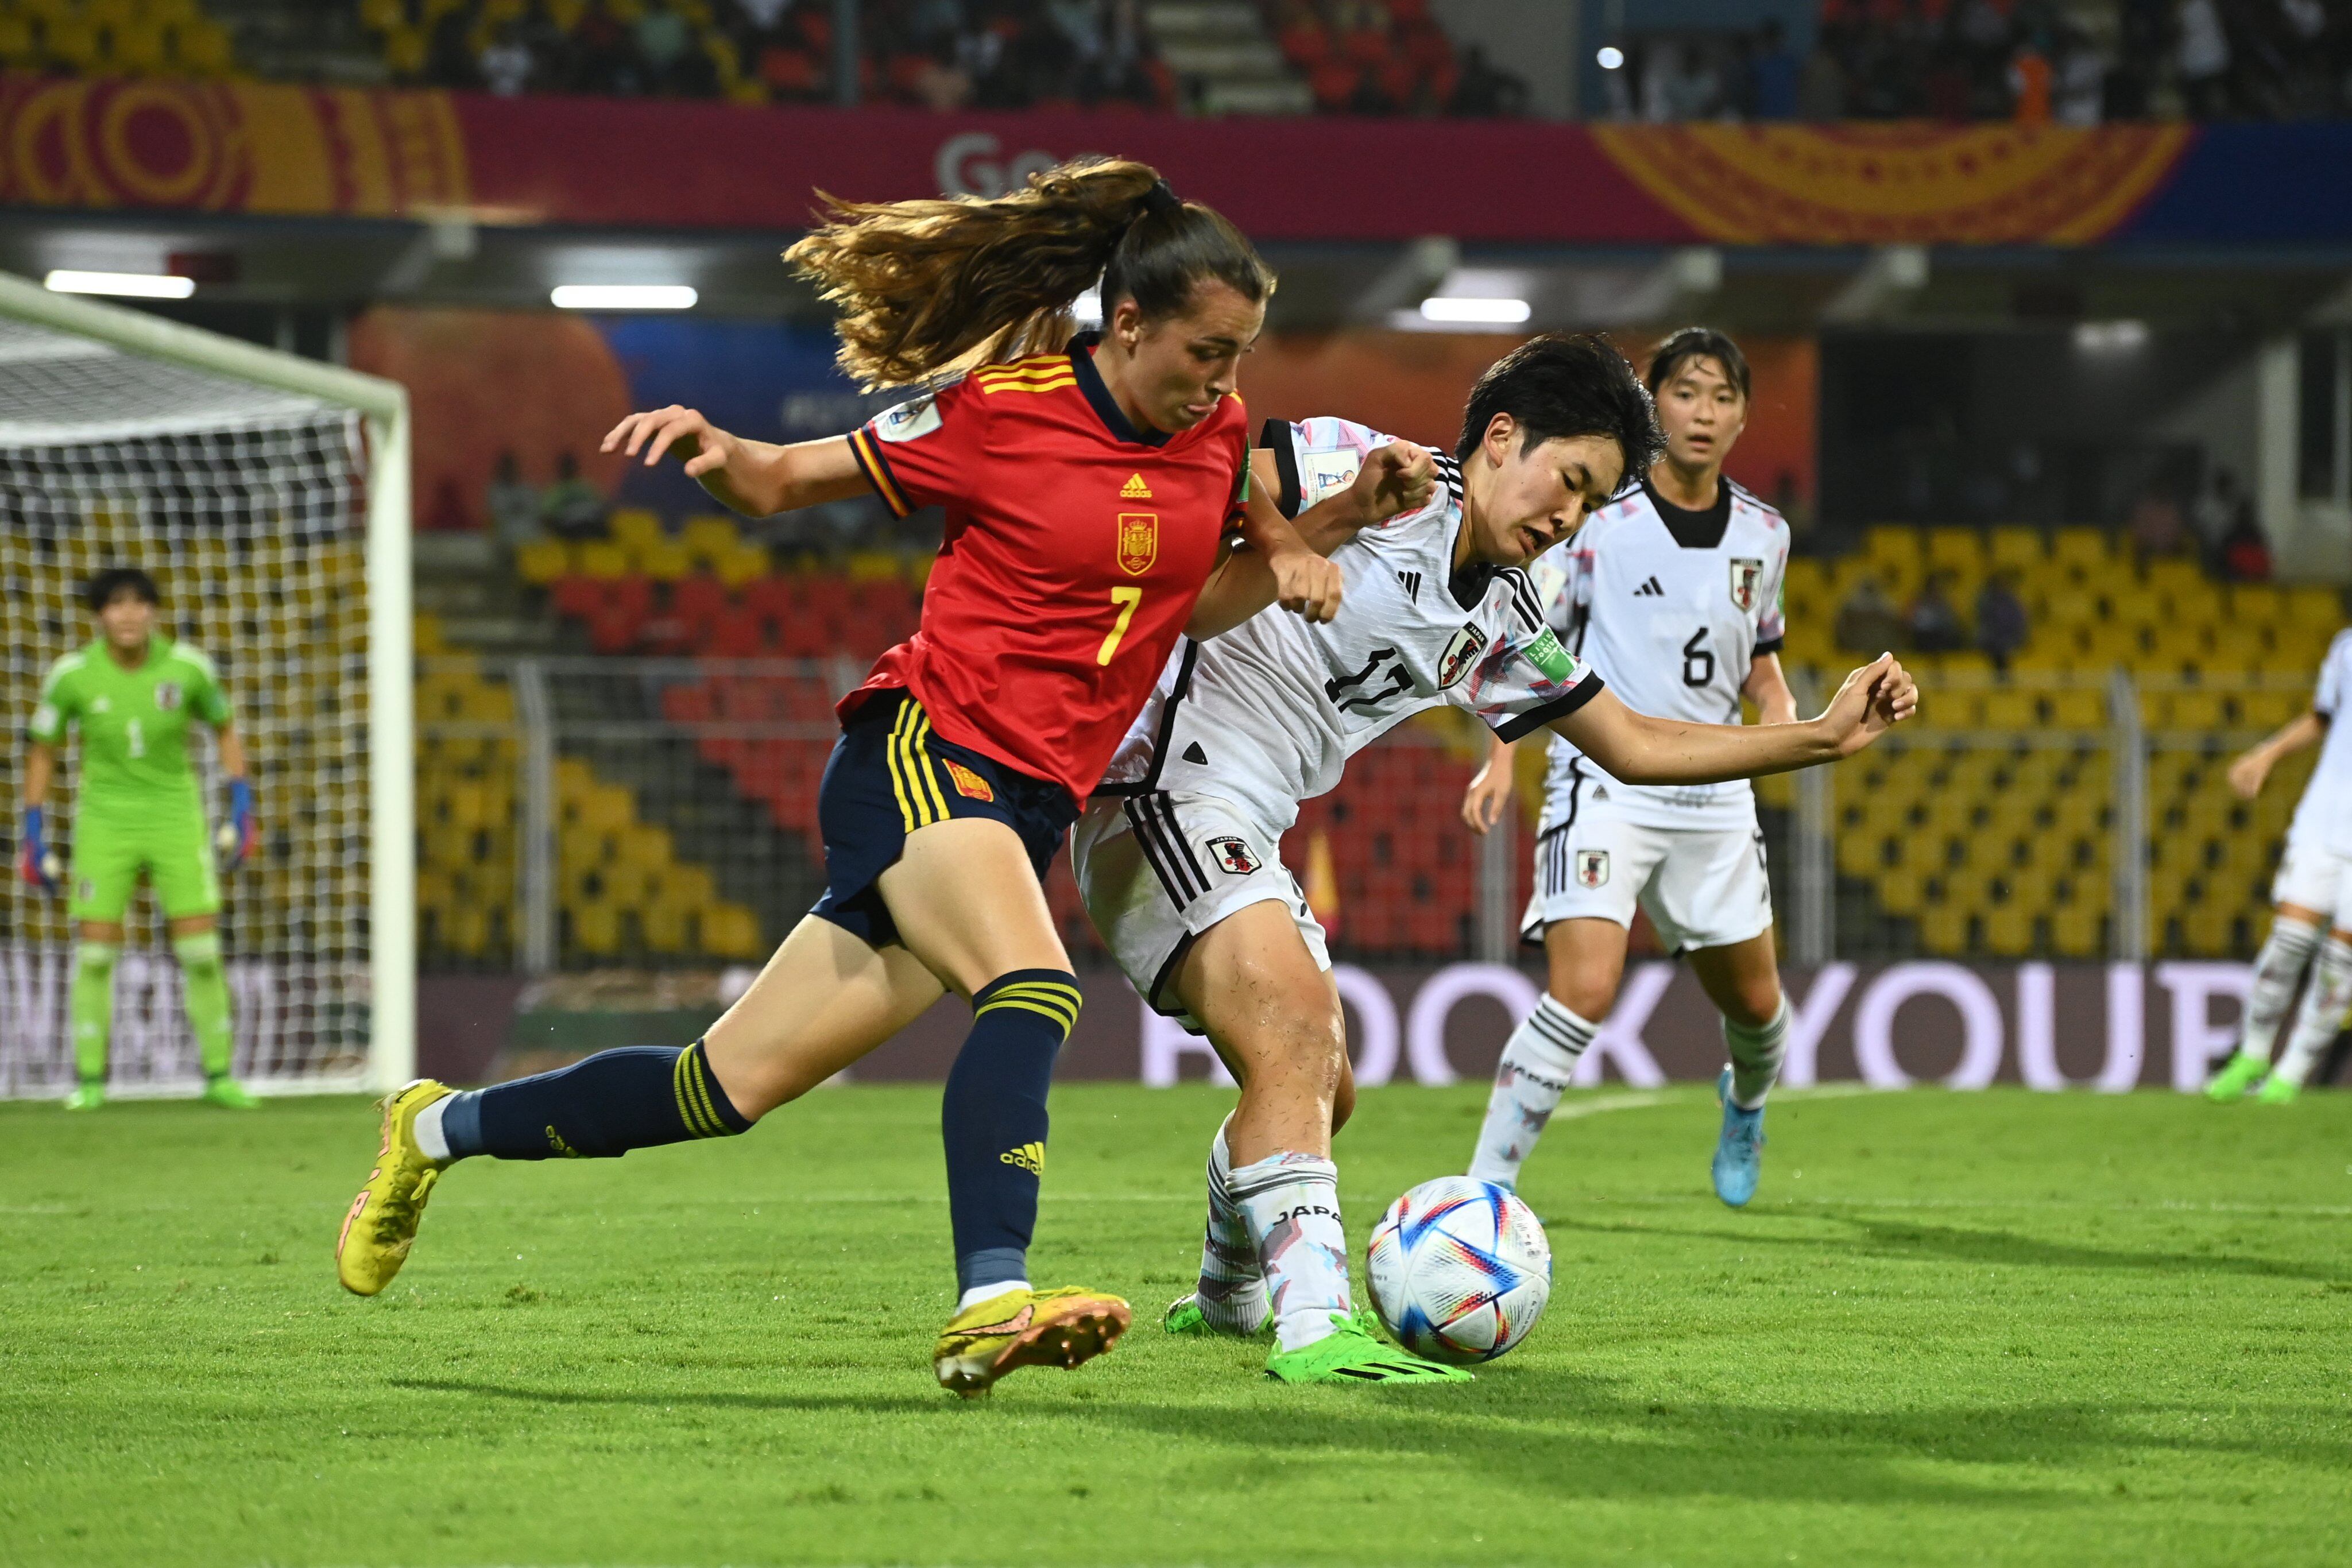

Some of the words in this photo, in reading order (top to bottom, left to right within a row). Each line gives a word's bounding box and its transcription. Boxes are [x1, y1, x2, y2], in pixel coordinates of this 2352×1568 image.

[935, 131, 1107, 202] Go
[1119, 489, 1152, 498] adidas
[1096, 586, 1143, 667] 7
[1469, 626, 1485, 642] JAPAN
[1529, 633, 1553, 657] LIVIN
[1684, 626, 1715, 687] 6
[1324, 646, 1415, 714] 17
[127, 717, 146, 758] 1
[1503, 1059, 1567, 1092] JAPAN
